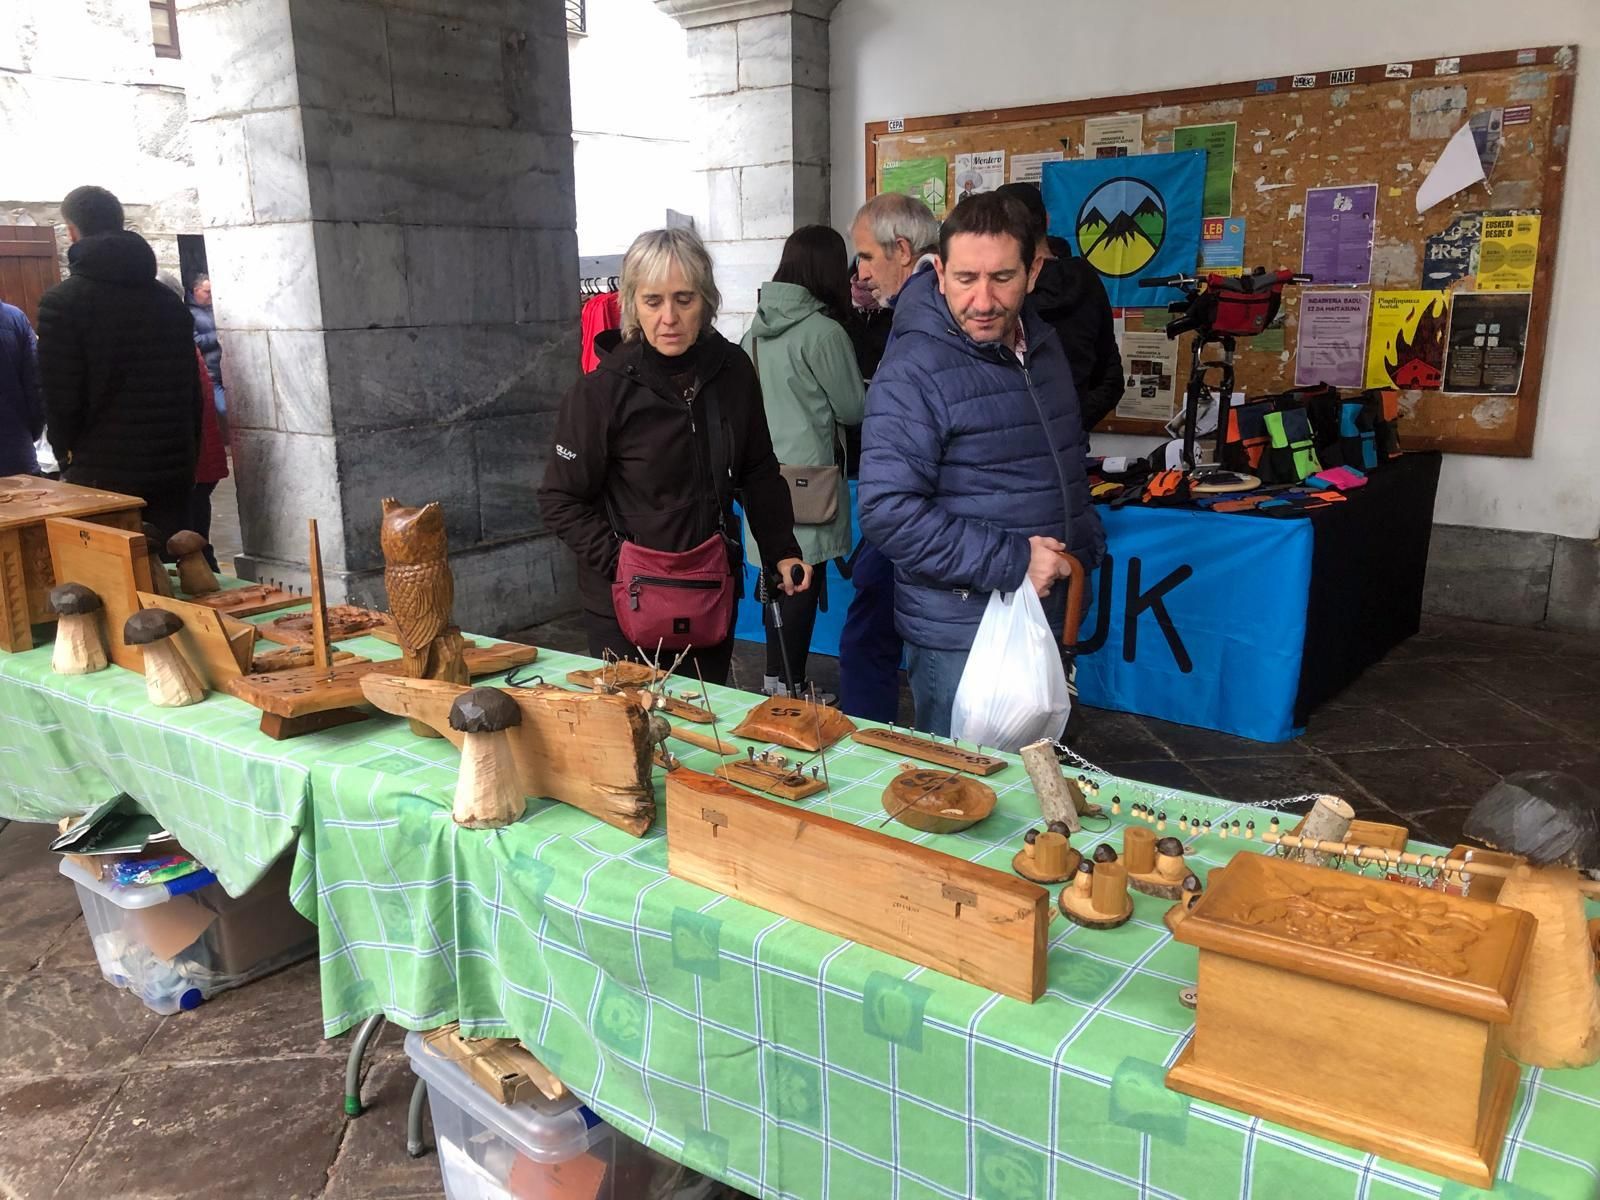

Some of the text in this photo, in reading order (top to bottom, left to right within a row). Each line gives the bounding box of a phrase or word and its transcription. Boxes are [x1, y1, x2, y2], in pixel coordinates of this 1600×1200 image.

[1331, 70, 1354, 84] HAKE
[889, 120, 902, 129] CEPA
[1485, 220, 1514, 229] EUSKERA
[1485, 229, 1505, 238] DESDE
